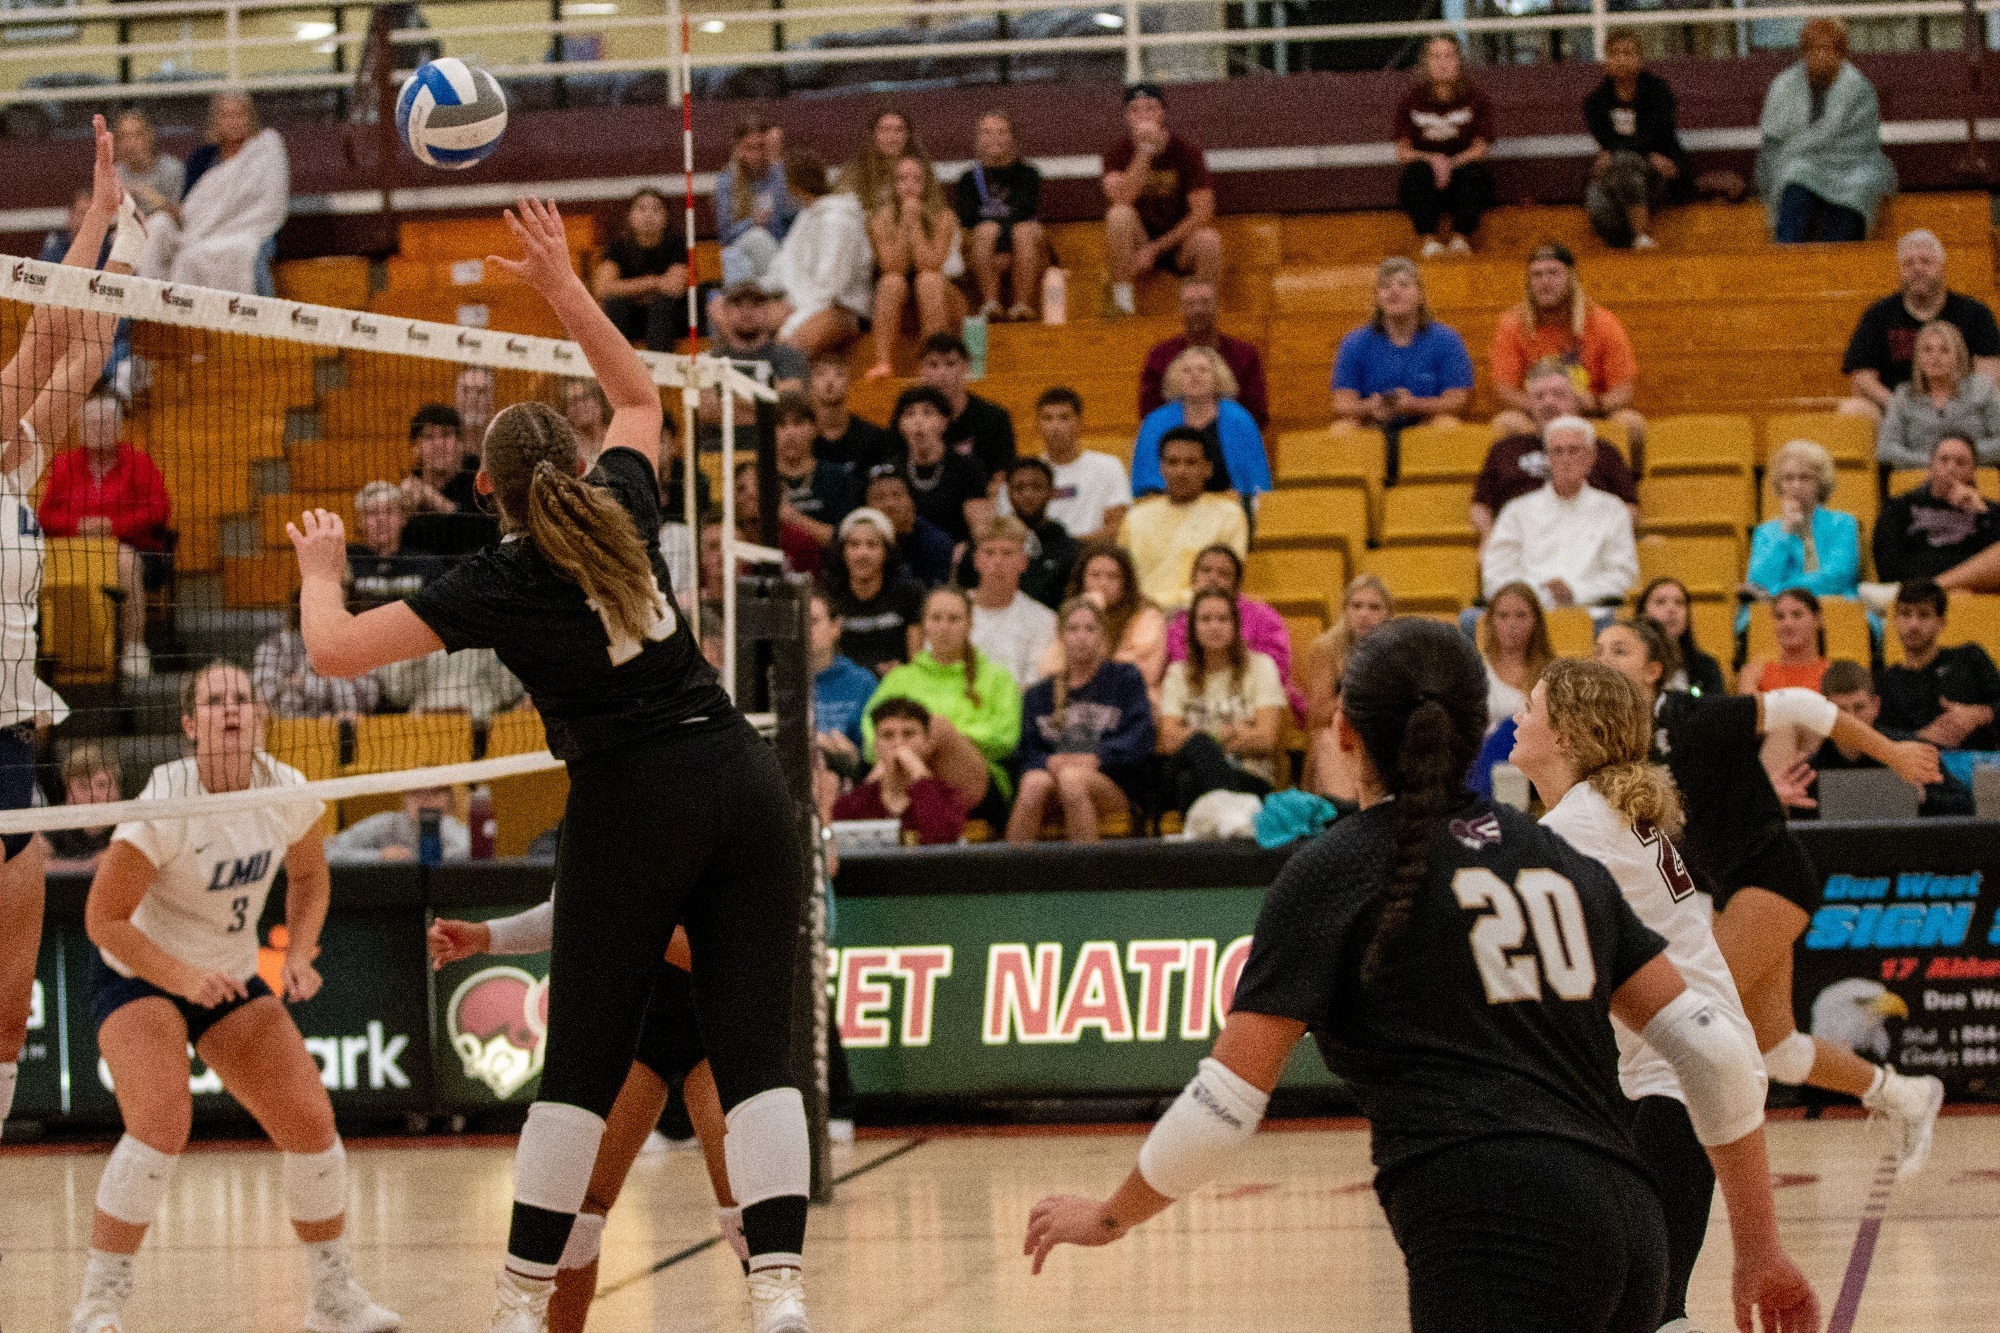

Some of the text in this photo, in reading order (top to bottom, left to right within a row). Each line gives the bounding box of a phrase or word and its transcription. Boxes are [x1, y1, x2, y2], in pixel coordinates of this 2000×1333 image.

[207, 848, 272, 892] LMU
[226, 896, 249, 934] 3
[1451, 867, 1597, 1004] 20
[1804, 901, 1976, 949] SIGN
[826, 945, 953, 1048] ET
[1923, 988, 1968, 1012] Due
